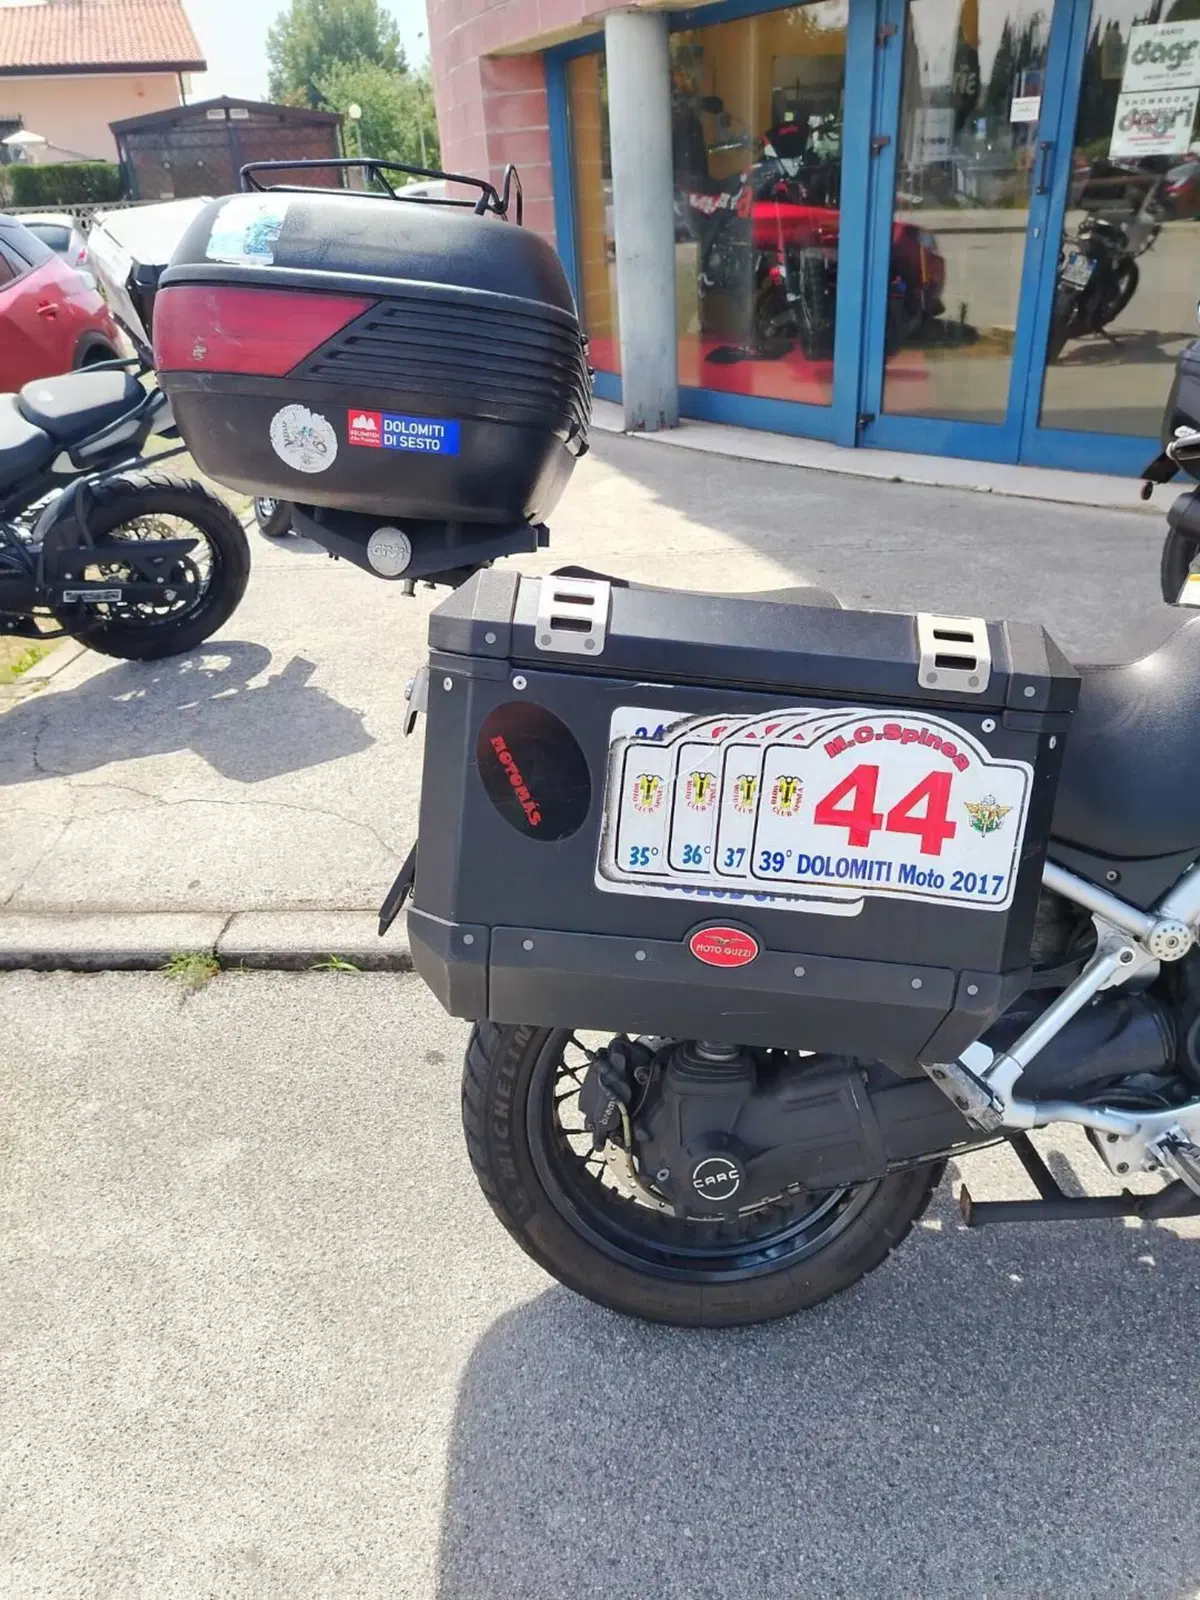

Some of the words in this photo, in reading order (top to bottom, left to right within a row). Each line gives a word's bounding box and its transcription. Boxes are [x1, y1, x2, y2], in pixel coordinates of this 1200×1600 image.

[384, 419, 444, 437] DOLOMITI
[384, 433, 397, 446] DI
[400, 435, 440, 451] SESTO
[823, 722, 970, 773] M.C.Spinea
[813, 763, 957, 856] 44
[724, 848, 747, 868] 37
[797, 854, 893, 882] DOLOMITI
[898, 863, 945, 889] Moto
[950, 870, 1004, 896] 2017
[696, 943, 722, 954] MOTO
[724, 947, 751, 958] GUZZI
[693, 1169, 740, 1188] CARC
